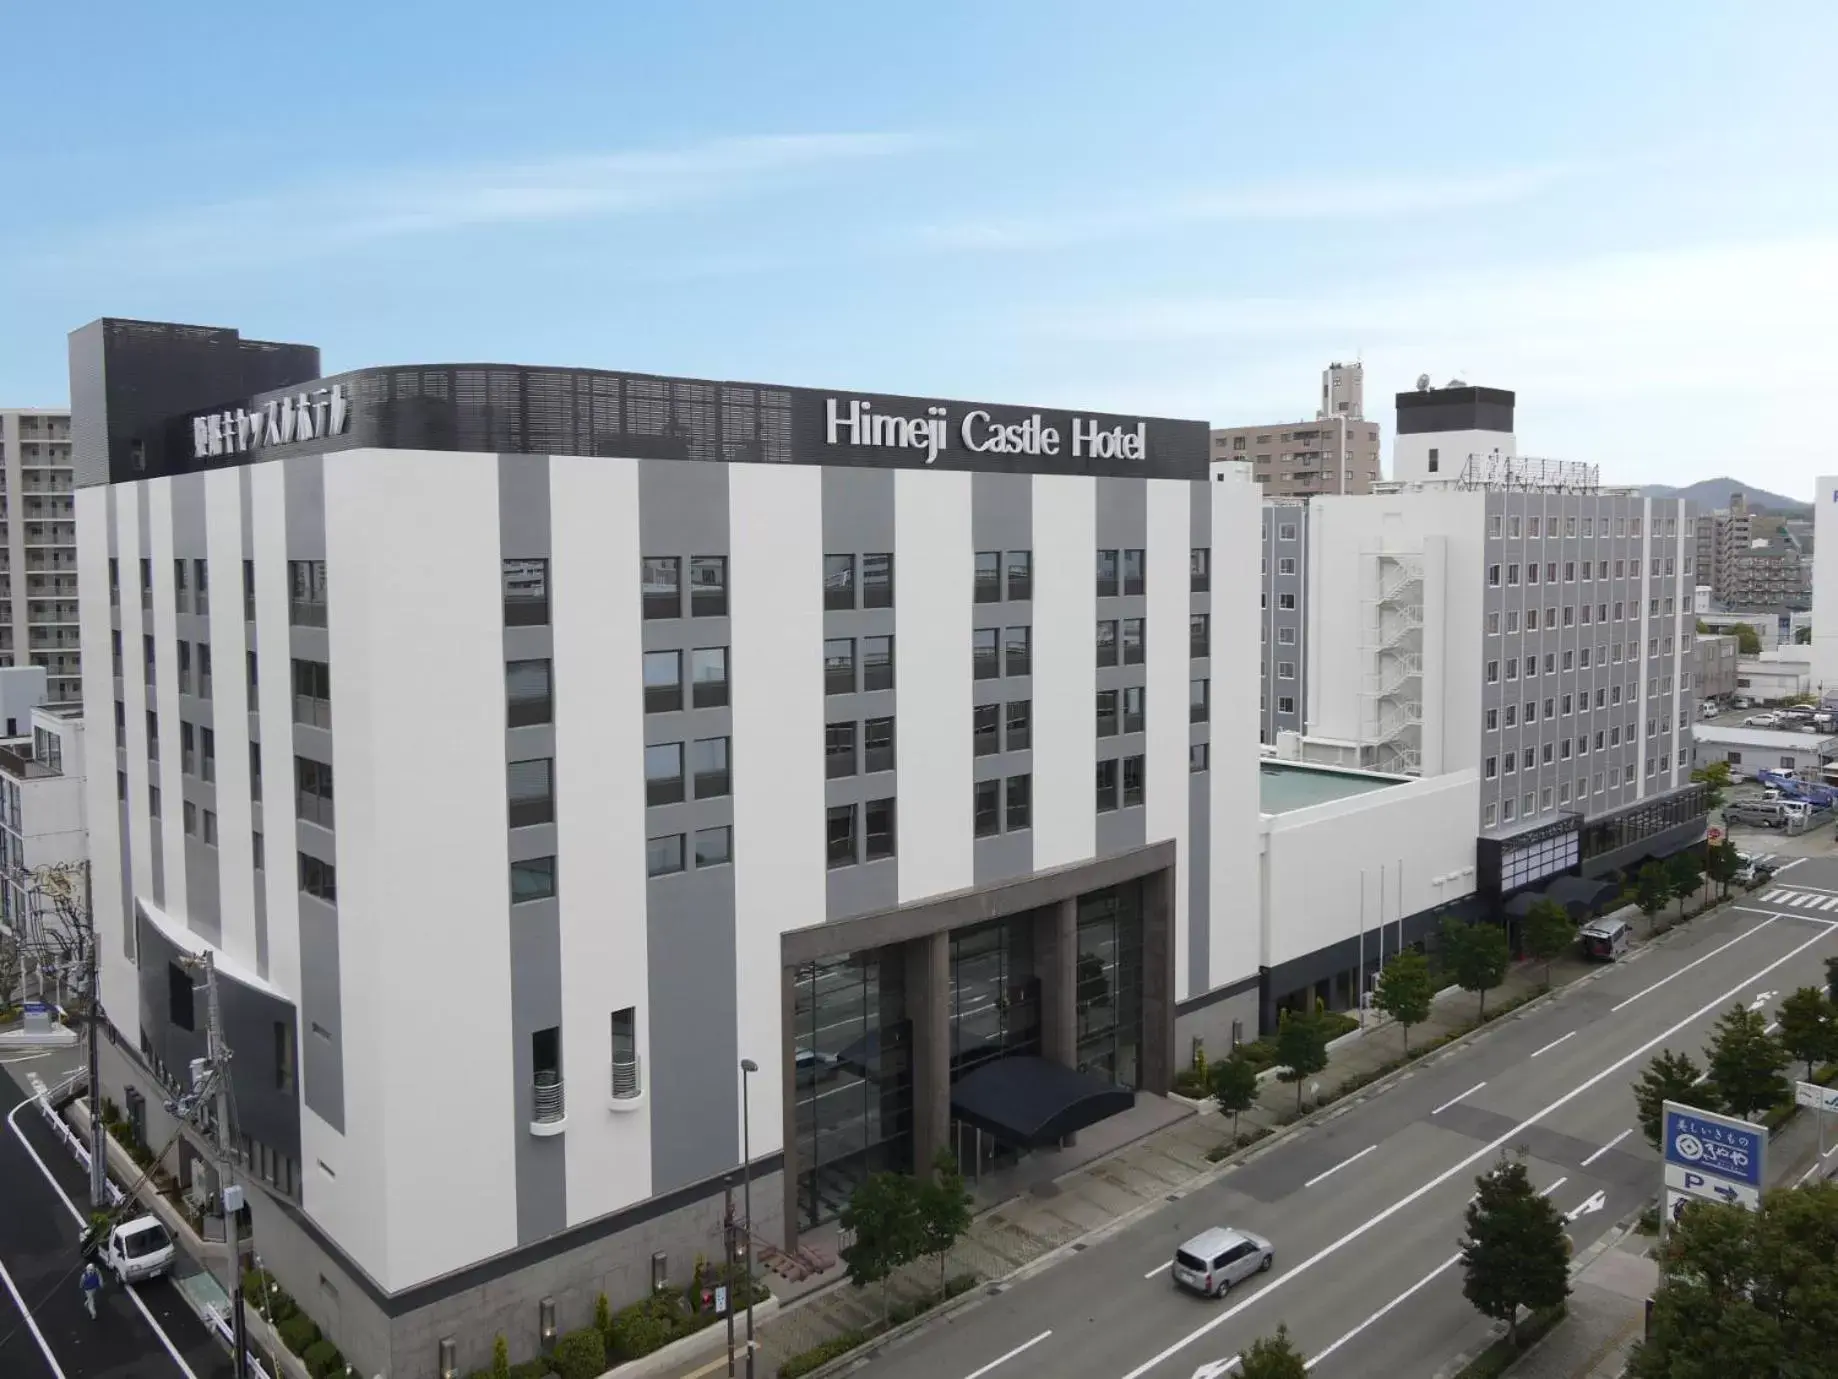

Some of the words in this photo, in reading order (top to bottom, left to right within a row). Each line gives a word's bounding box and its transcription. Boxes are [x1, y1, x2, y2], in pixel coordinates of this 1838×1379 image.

[826, 398, 947, 464] Himeji
[962, 410, 1060, 453] Castle
[1072, 417, 1146, 460] Hotel
[1684, 1171, 1705, 1188] P
